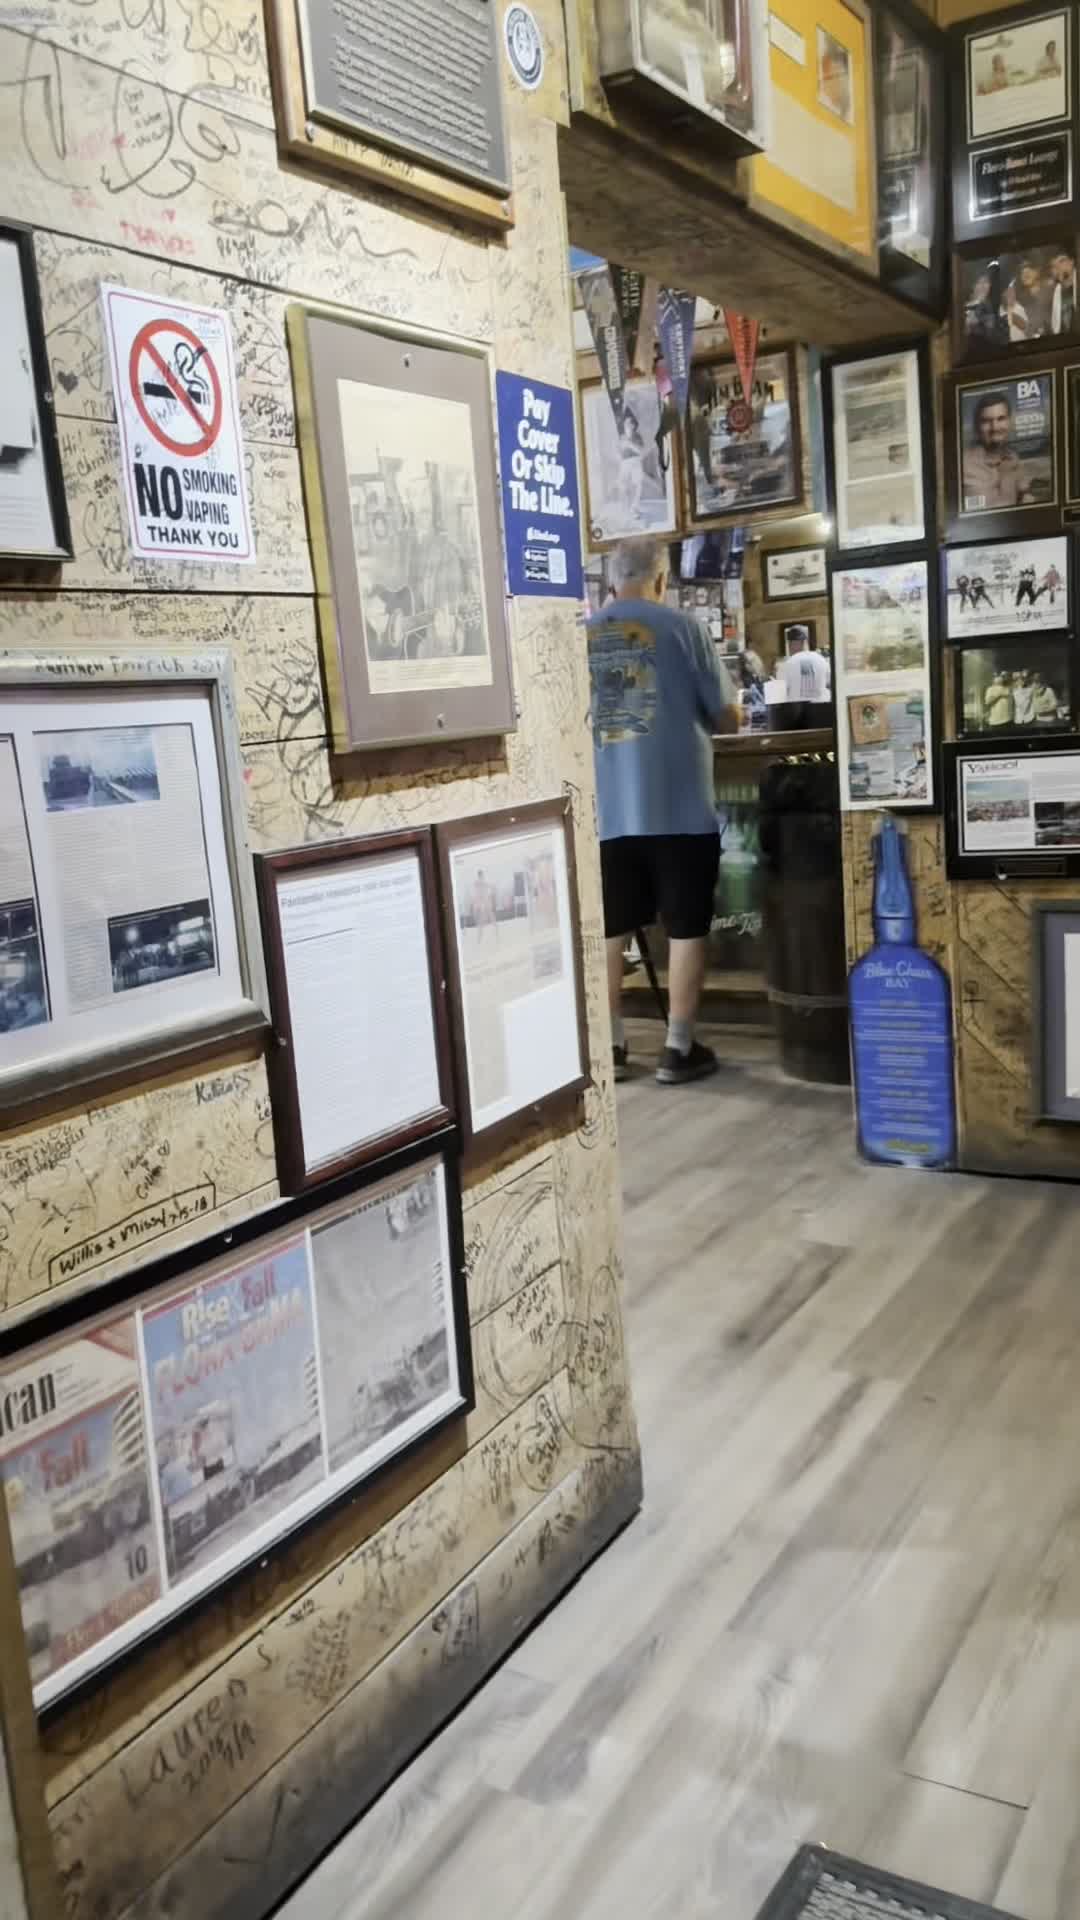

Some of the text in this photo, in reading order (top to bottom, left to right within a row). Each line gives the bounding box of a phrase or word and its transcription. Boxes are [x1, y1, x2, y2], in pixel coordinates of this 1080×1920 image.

[1016, 379, 1041, 400] BA
[522, 388, 551, 427] Pay
[517, 419, 561, 454] Cover
[182, 468, 238, 496] SMOKING
[511, 449, 567, 490] Or Skip
[133, 463, 184, 521] NO
[508, 480, 575, 518] The Line.
[185, 499, 230, 526] VAPING
[146, 525, 240, 548] THANK YOU
[59, 1242, 104, 1275] Willis
[125, 1545, 149, 1581] 10
[119, 1677, 249, 1813] Lauren
